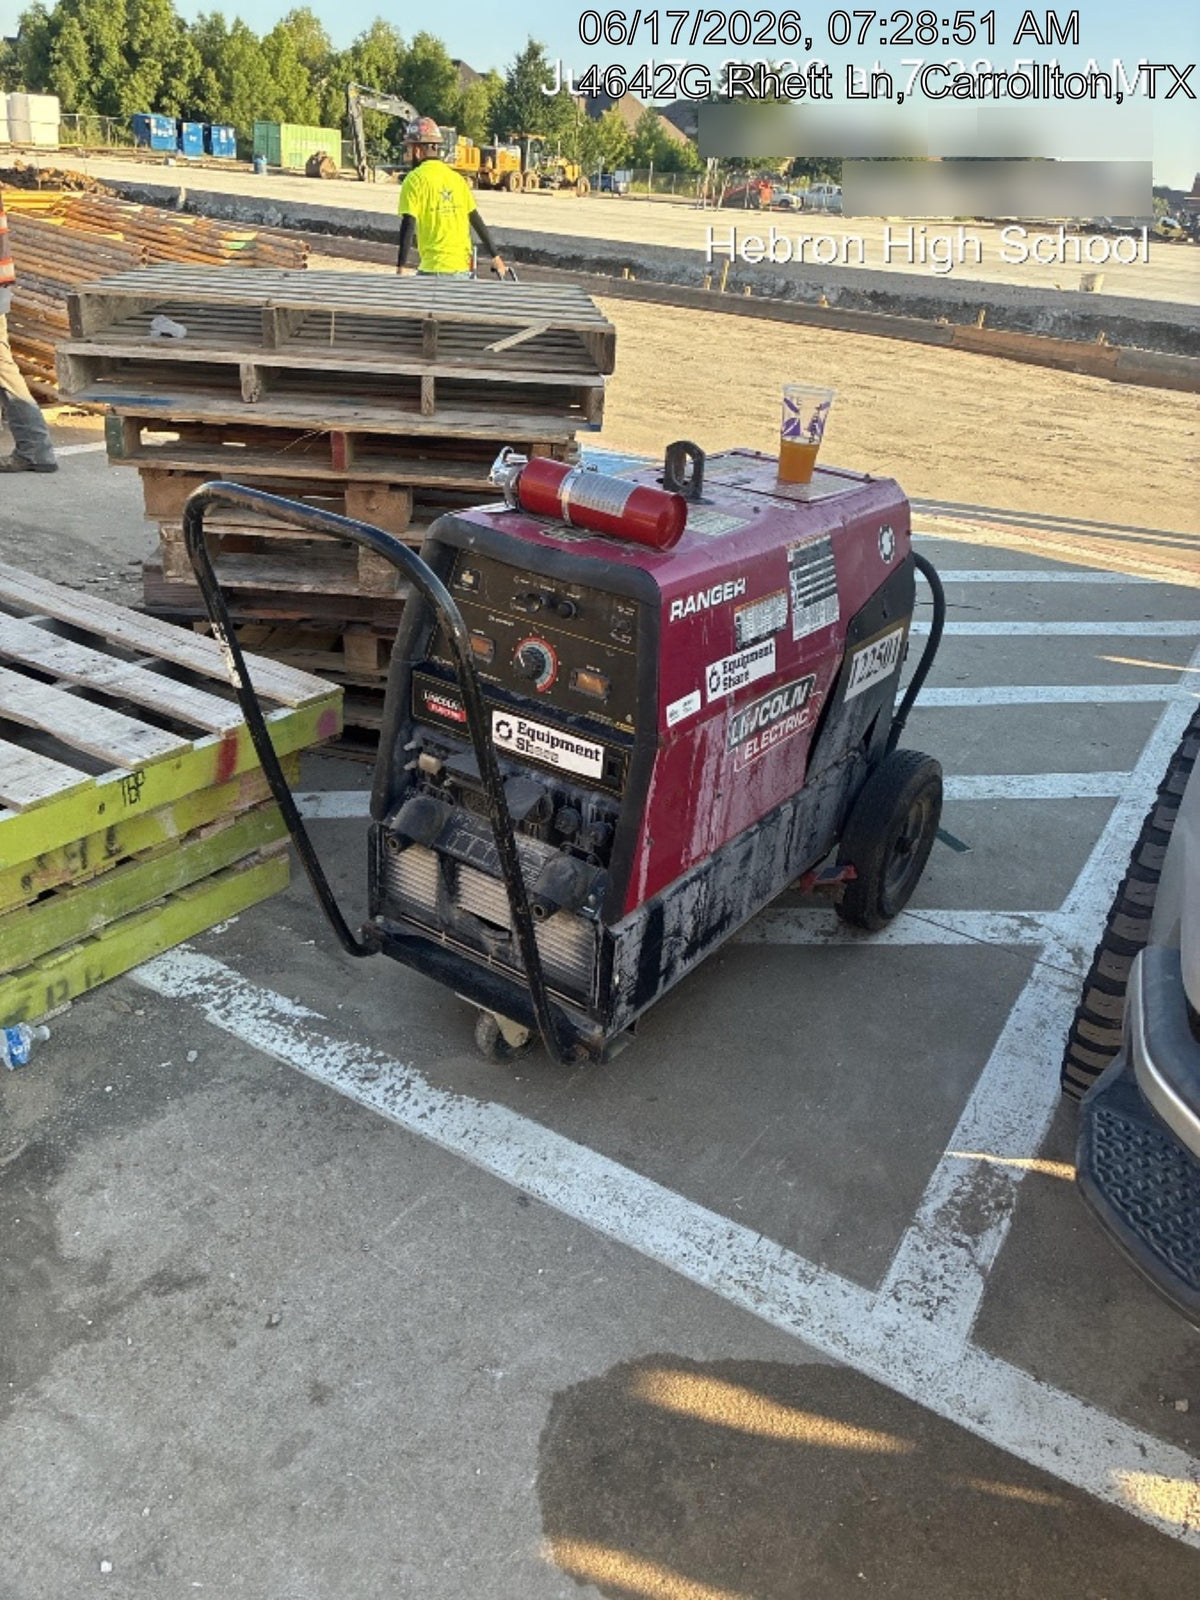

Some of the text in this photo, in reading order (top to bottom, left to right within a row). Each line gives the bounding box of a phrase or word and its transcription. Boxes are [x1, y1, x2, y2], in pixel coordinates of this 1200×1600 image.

[669, 577, 746, 622] RANGER
[722, 642, 774, 675] Equipment
[722, 670, 750, 691] Share
[729, 682, 810, 746] LINCOLN
[744, 708, 810, 760] ELECTRIC
[516, 721, 601, 762] Equipment
